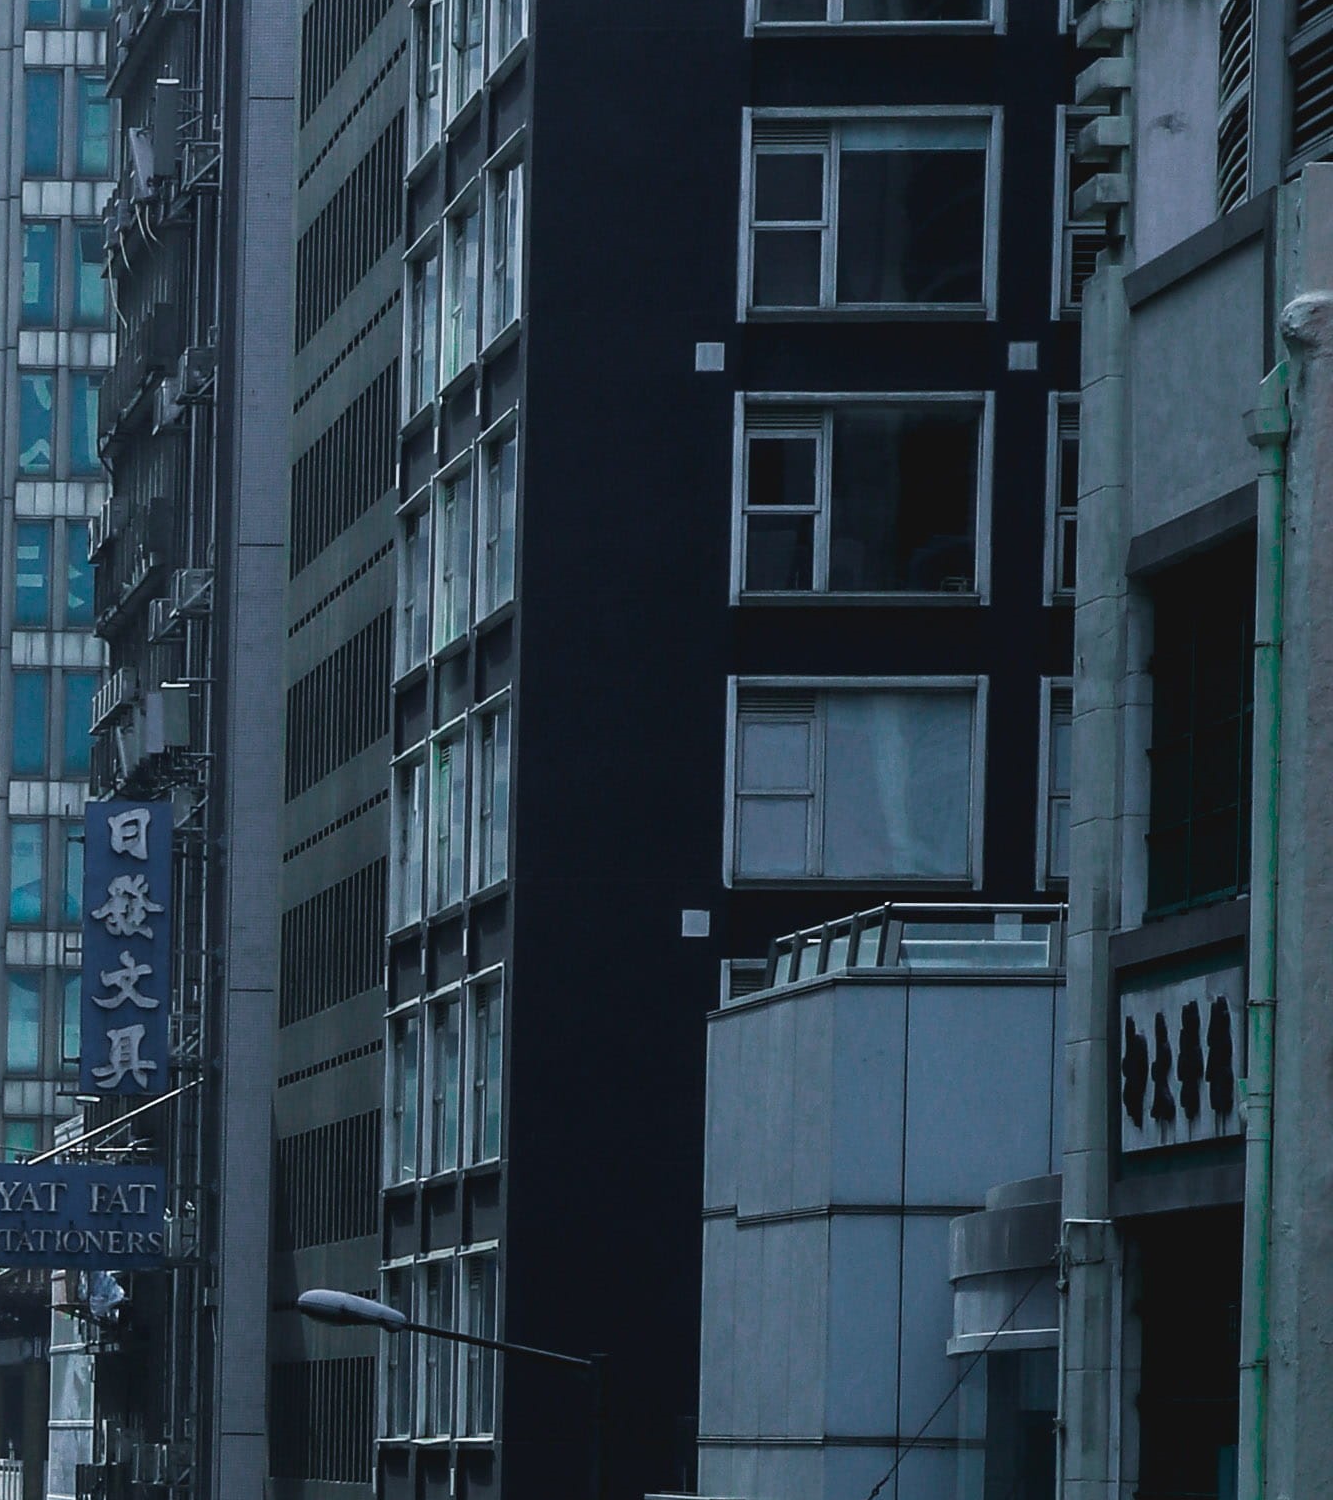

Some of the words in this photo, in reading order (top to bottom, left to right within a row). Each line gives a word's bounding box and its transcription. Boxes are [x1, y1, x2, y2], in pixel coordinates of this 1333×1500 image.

[91, 807, 165, 1091] 日發文具
[90, 1183, 157, 1214] FAT
